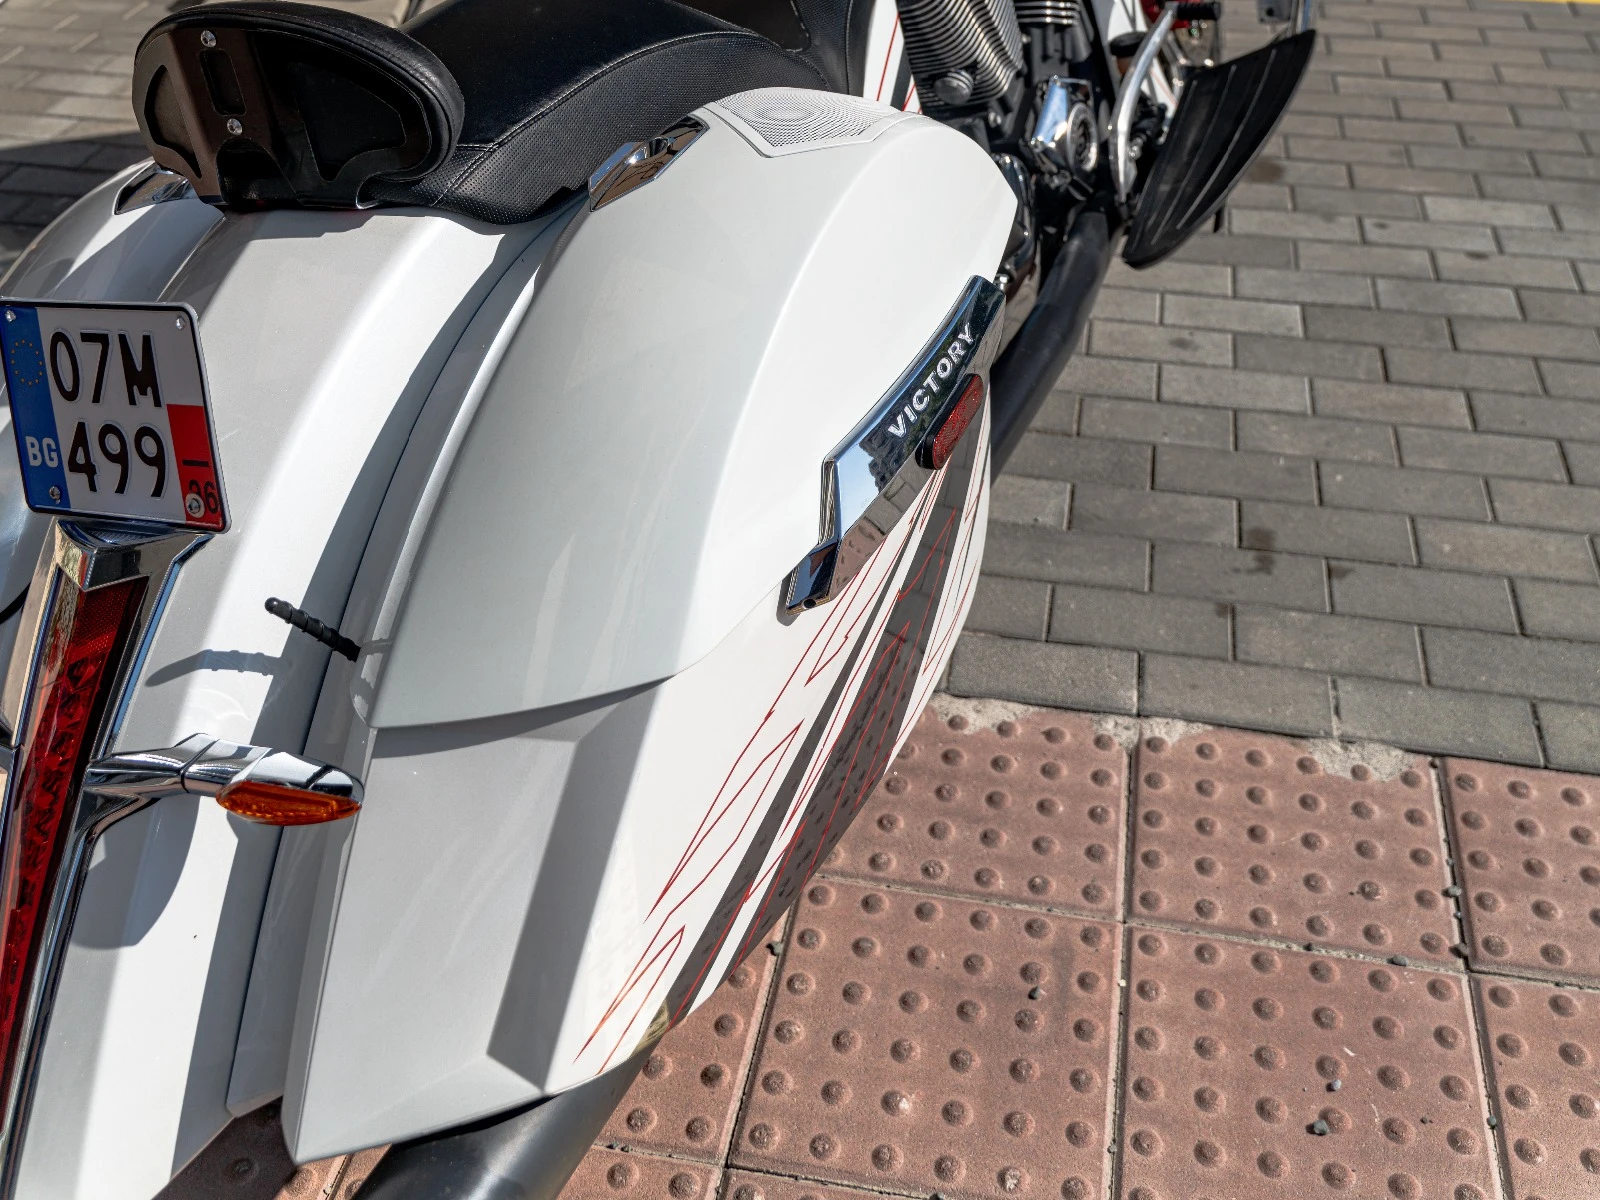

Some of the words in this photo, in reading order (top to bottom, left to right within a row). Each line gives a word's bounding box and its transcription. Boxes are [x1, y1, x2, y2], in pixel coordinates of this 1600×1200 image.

[50, 331, 162, 407] 07M
[887, 322, 975, 438] VICTORY
[25, 435, 59, 468] BG
[67, 420, 166, 498] 499
